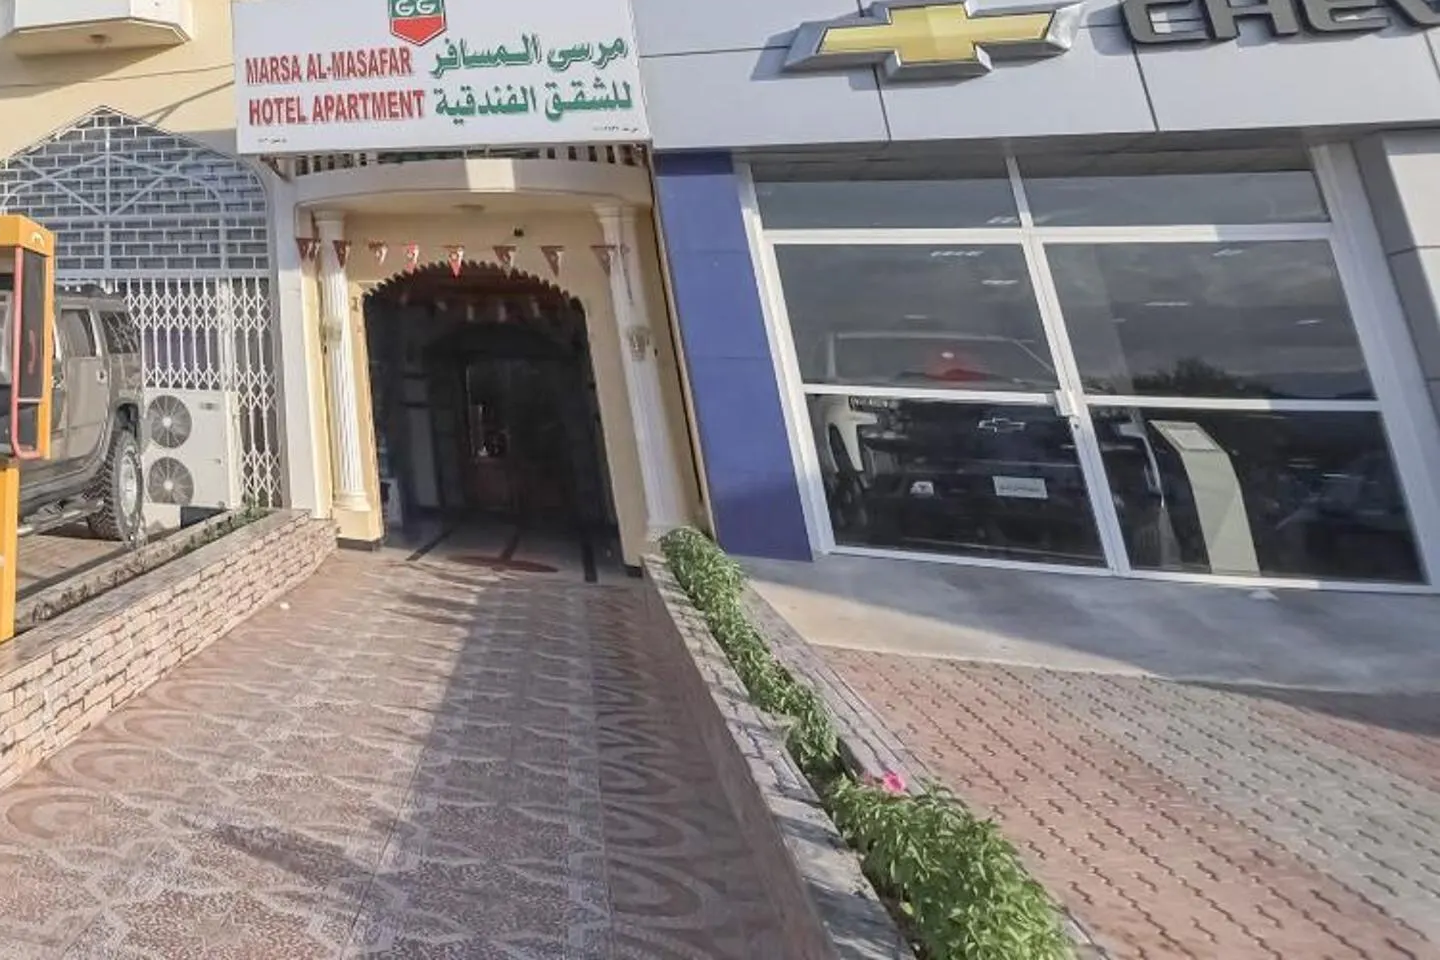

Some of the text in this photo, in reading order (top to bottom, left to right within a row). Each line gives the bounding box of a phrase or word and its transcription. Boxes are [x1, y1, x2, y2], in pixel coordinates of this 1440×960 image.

[245, 45, 413, 86] MARSA AL-MASAFAR
[429, 33, 542, 79] المسافر
[248, 89, 425, 127] HOTEL APARTMENT
[433, 77, 633, 126] للشقق الفندقية
